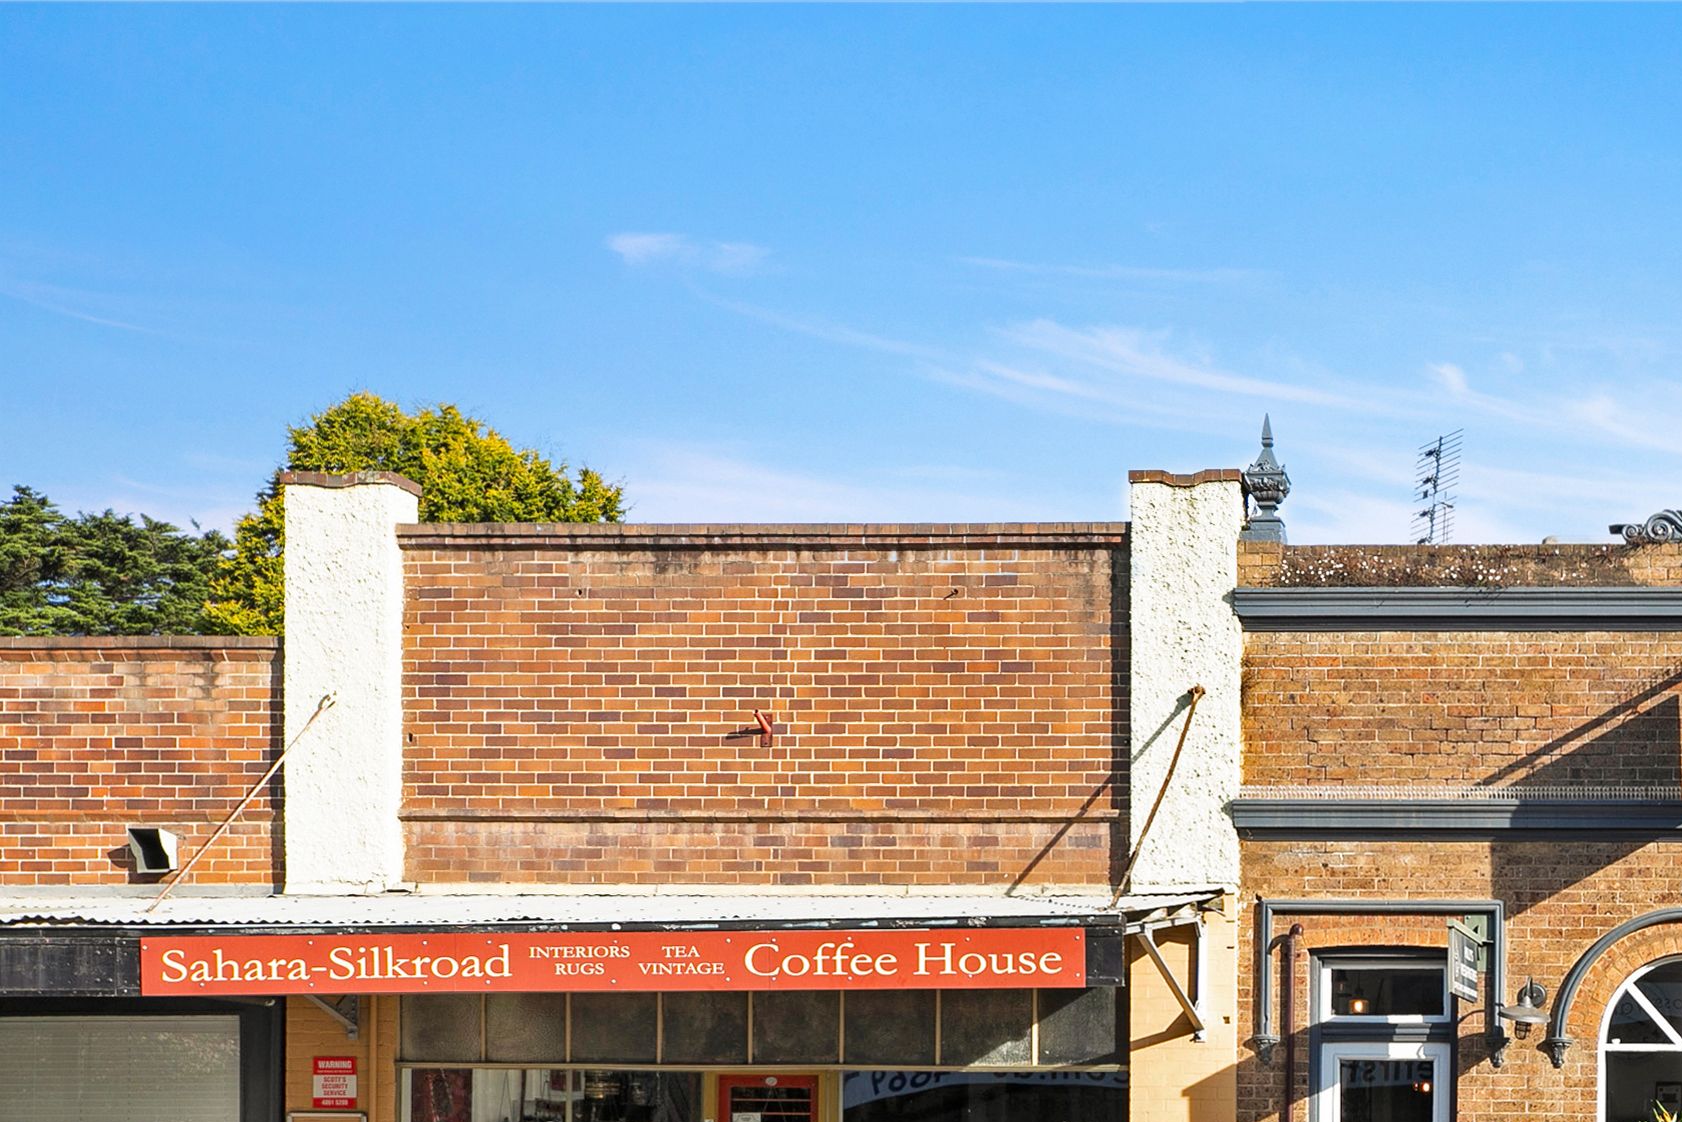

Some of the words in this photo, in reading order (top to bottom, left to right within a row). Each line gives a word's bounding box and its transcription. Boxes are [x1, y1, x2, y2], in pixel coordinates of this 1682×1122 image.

[528, 946, 631, 960] INTERIORS
[662, 946, 700, 959] TEA
[161, 944, 513, 984] Sahara-Silkroad
[744, 942, 898, 978] Coffee
[913, 942, 1063, 976] House
[554, 962, 605, 977] RUGS
[638, 962, 726, 976] VINTAGE
[317, 1060, 353, 1069] WARNING
